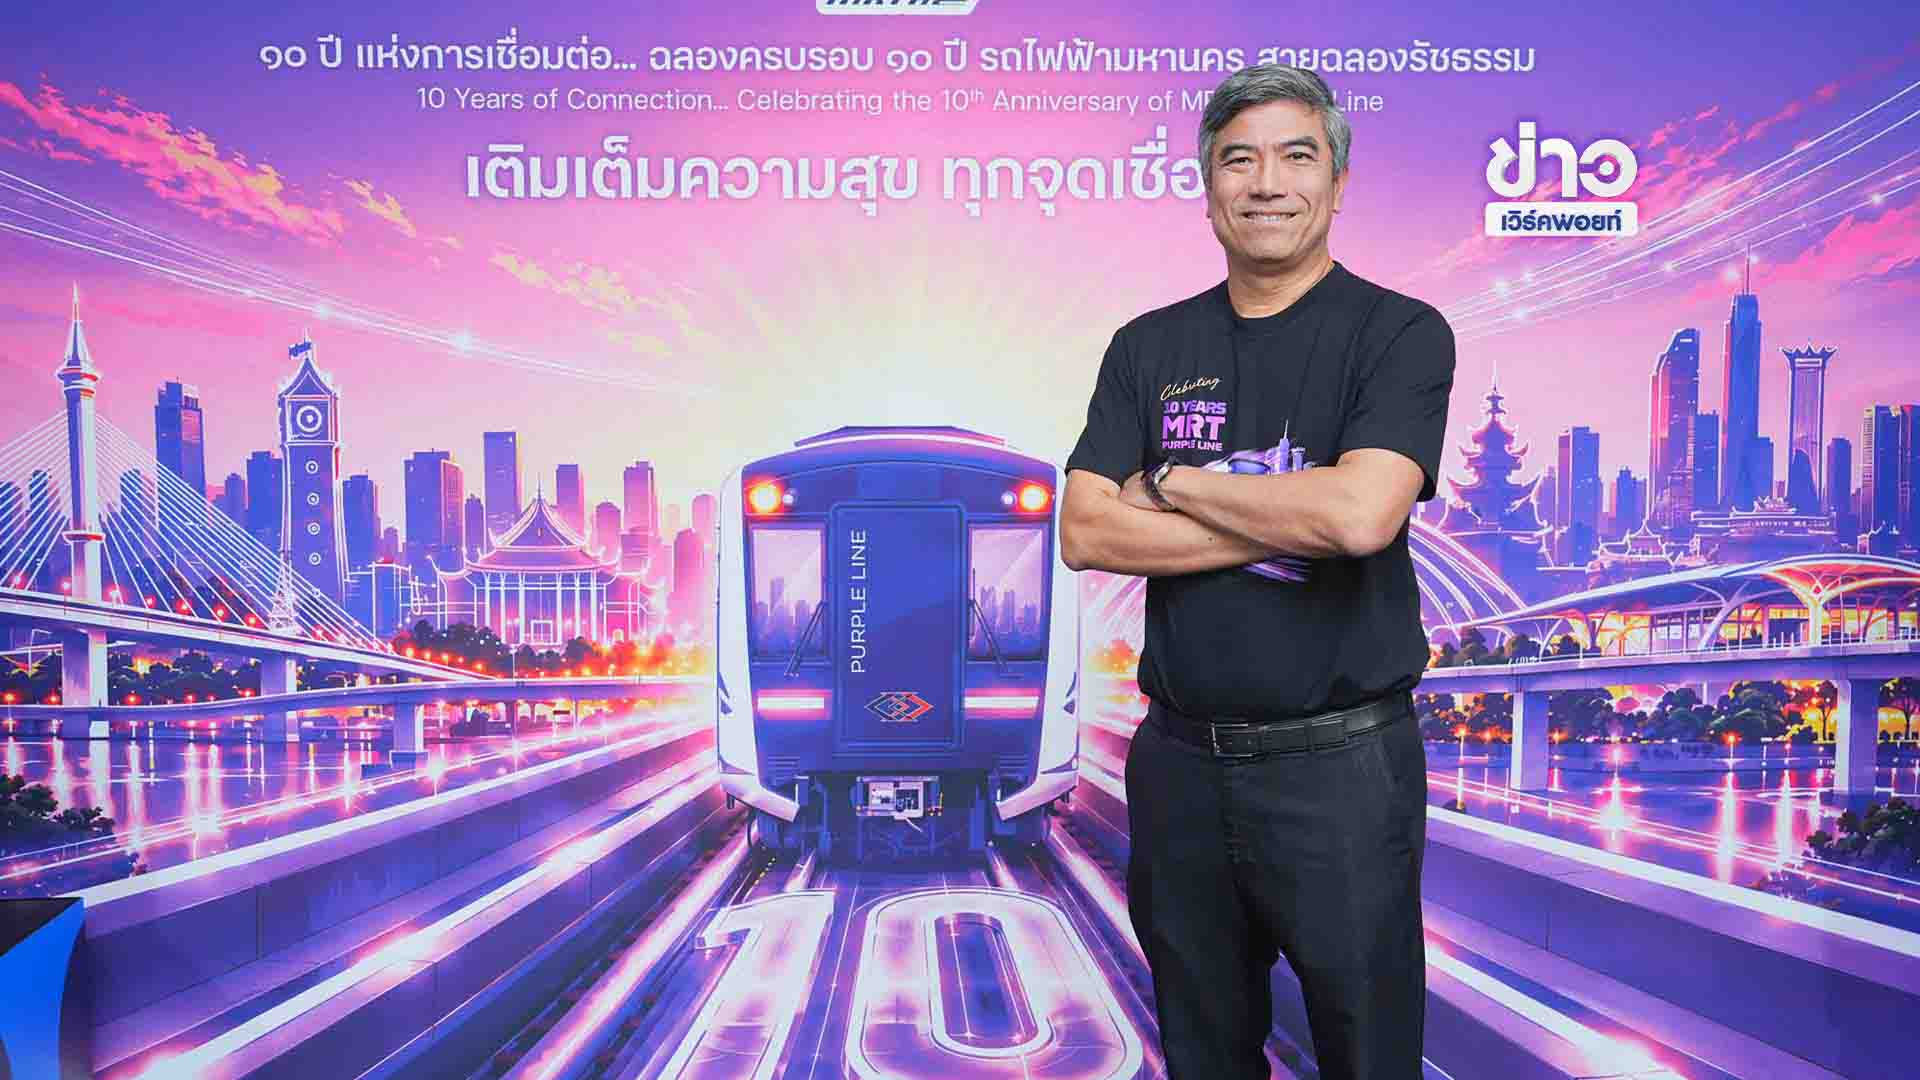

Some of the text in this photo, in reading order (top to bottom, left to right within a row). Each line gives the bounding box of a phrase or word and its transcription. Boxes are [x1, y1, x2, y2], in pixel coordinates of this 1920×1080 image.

[259, 46, 307, 69] ๑๐
[317, 35, 342, 68] ปี
[356, 26, 637, 70] แห่งการเชื่อมต่อ...
[649, 44, 873, 71] ฉลองครบรอบ
[887, 48, 932, 72] ๑๐
[943, 39, 967, 71] ปี
[980, 38, 1245, 72] รถไฟฟ้ามหานคร
[417, 88, 445, 109] 10
[454, 88, 524, 109] Years
[533, 87, 558, 109] of
[567, 88, 728, 110] Connection...
[738, 88, 883, 115] Celebrating
[893, 90, 932, 111] the
[992, 91, 1139, 115] Anniversary
[1148, 91, 1173, 112] of
[466, 126, 1206, 217] เติมเต็มความสุข ทุกจุดเชื่อ
[1163, 401, 1227, 415] 10 YEARS
[1162, 414, 1226, 441] MRT
[1197, 441, 1223, 451] LINE
[850, 528, 866, 673] PURPLE LINE
